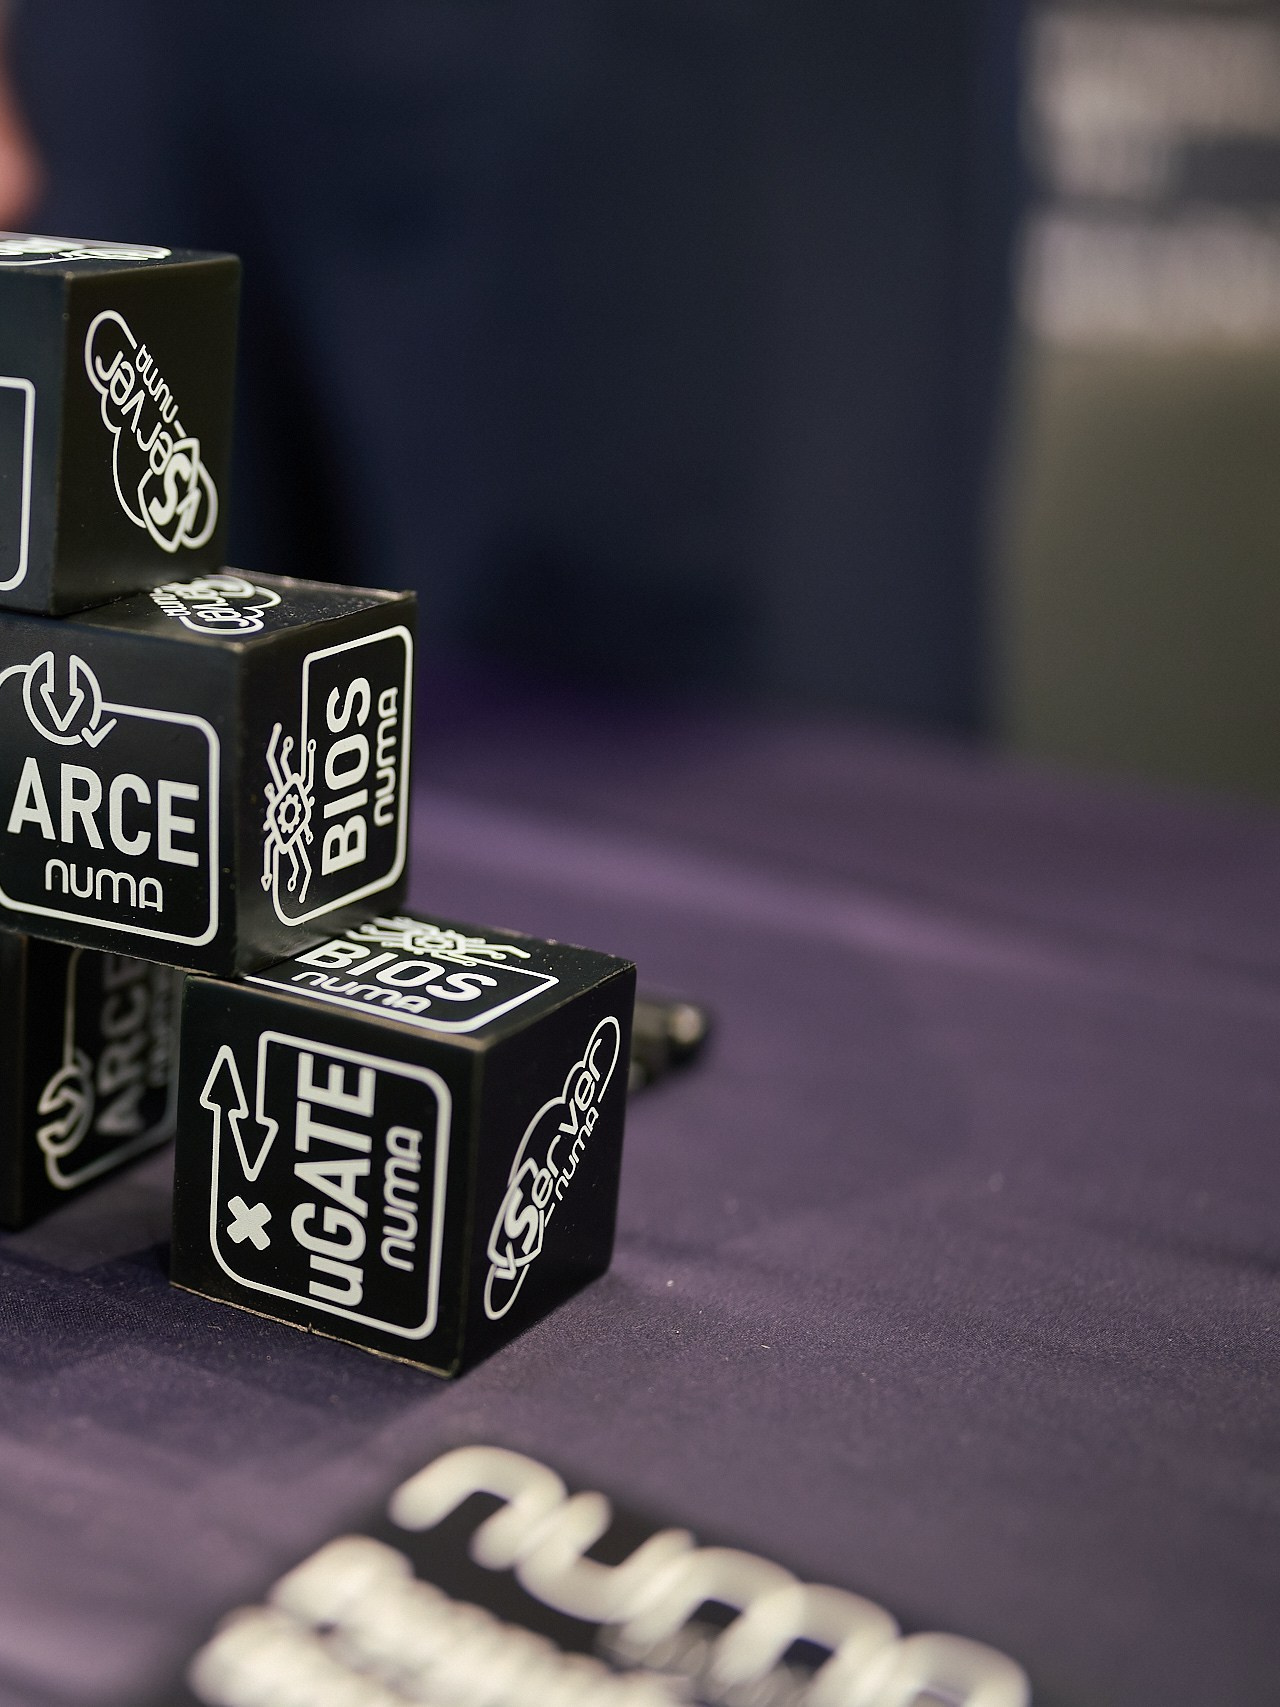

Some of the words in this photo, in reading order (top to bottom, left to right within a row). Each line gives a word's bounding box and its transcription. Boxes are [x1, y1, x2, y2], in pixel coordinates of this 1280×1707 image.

[7, 756, 200, 868] ARCE
[321, 677, 371, 876] BIOS
[294, 940, 498, 1002] BIOS
[290, 1051, 377, 1307] uGATE
